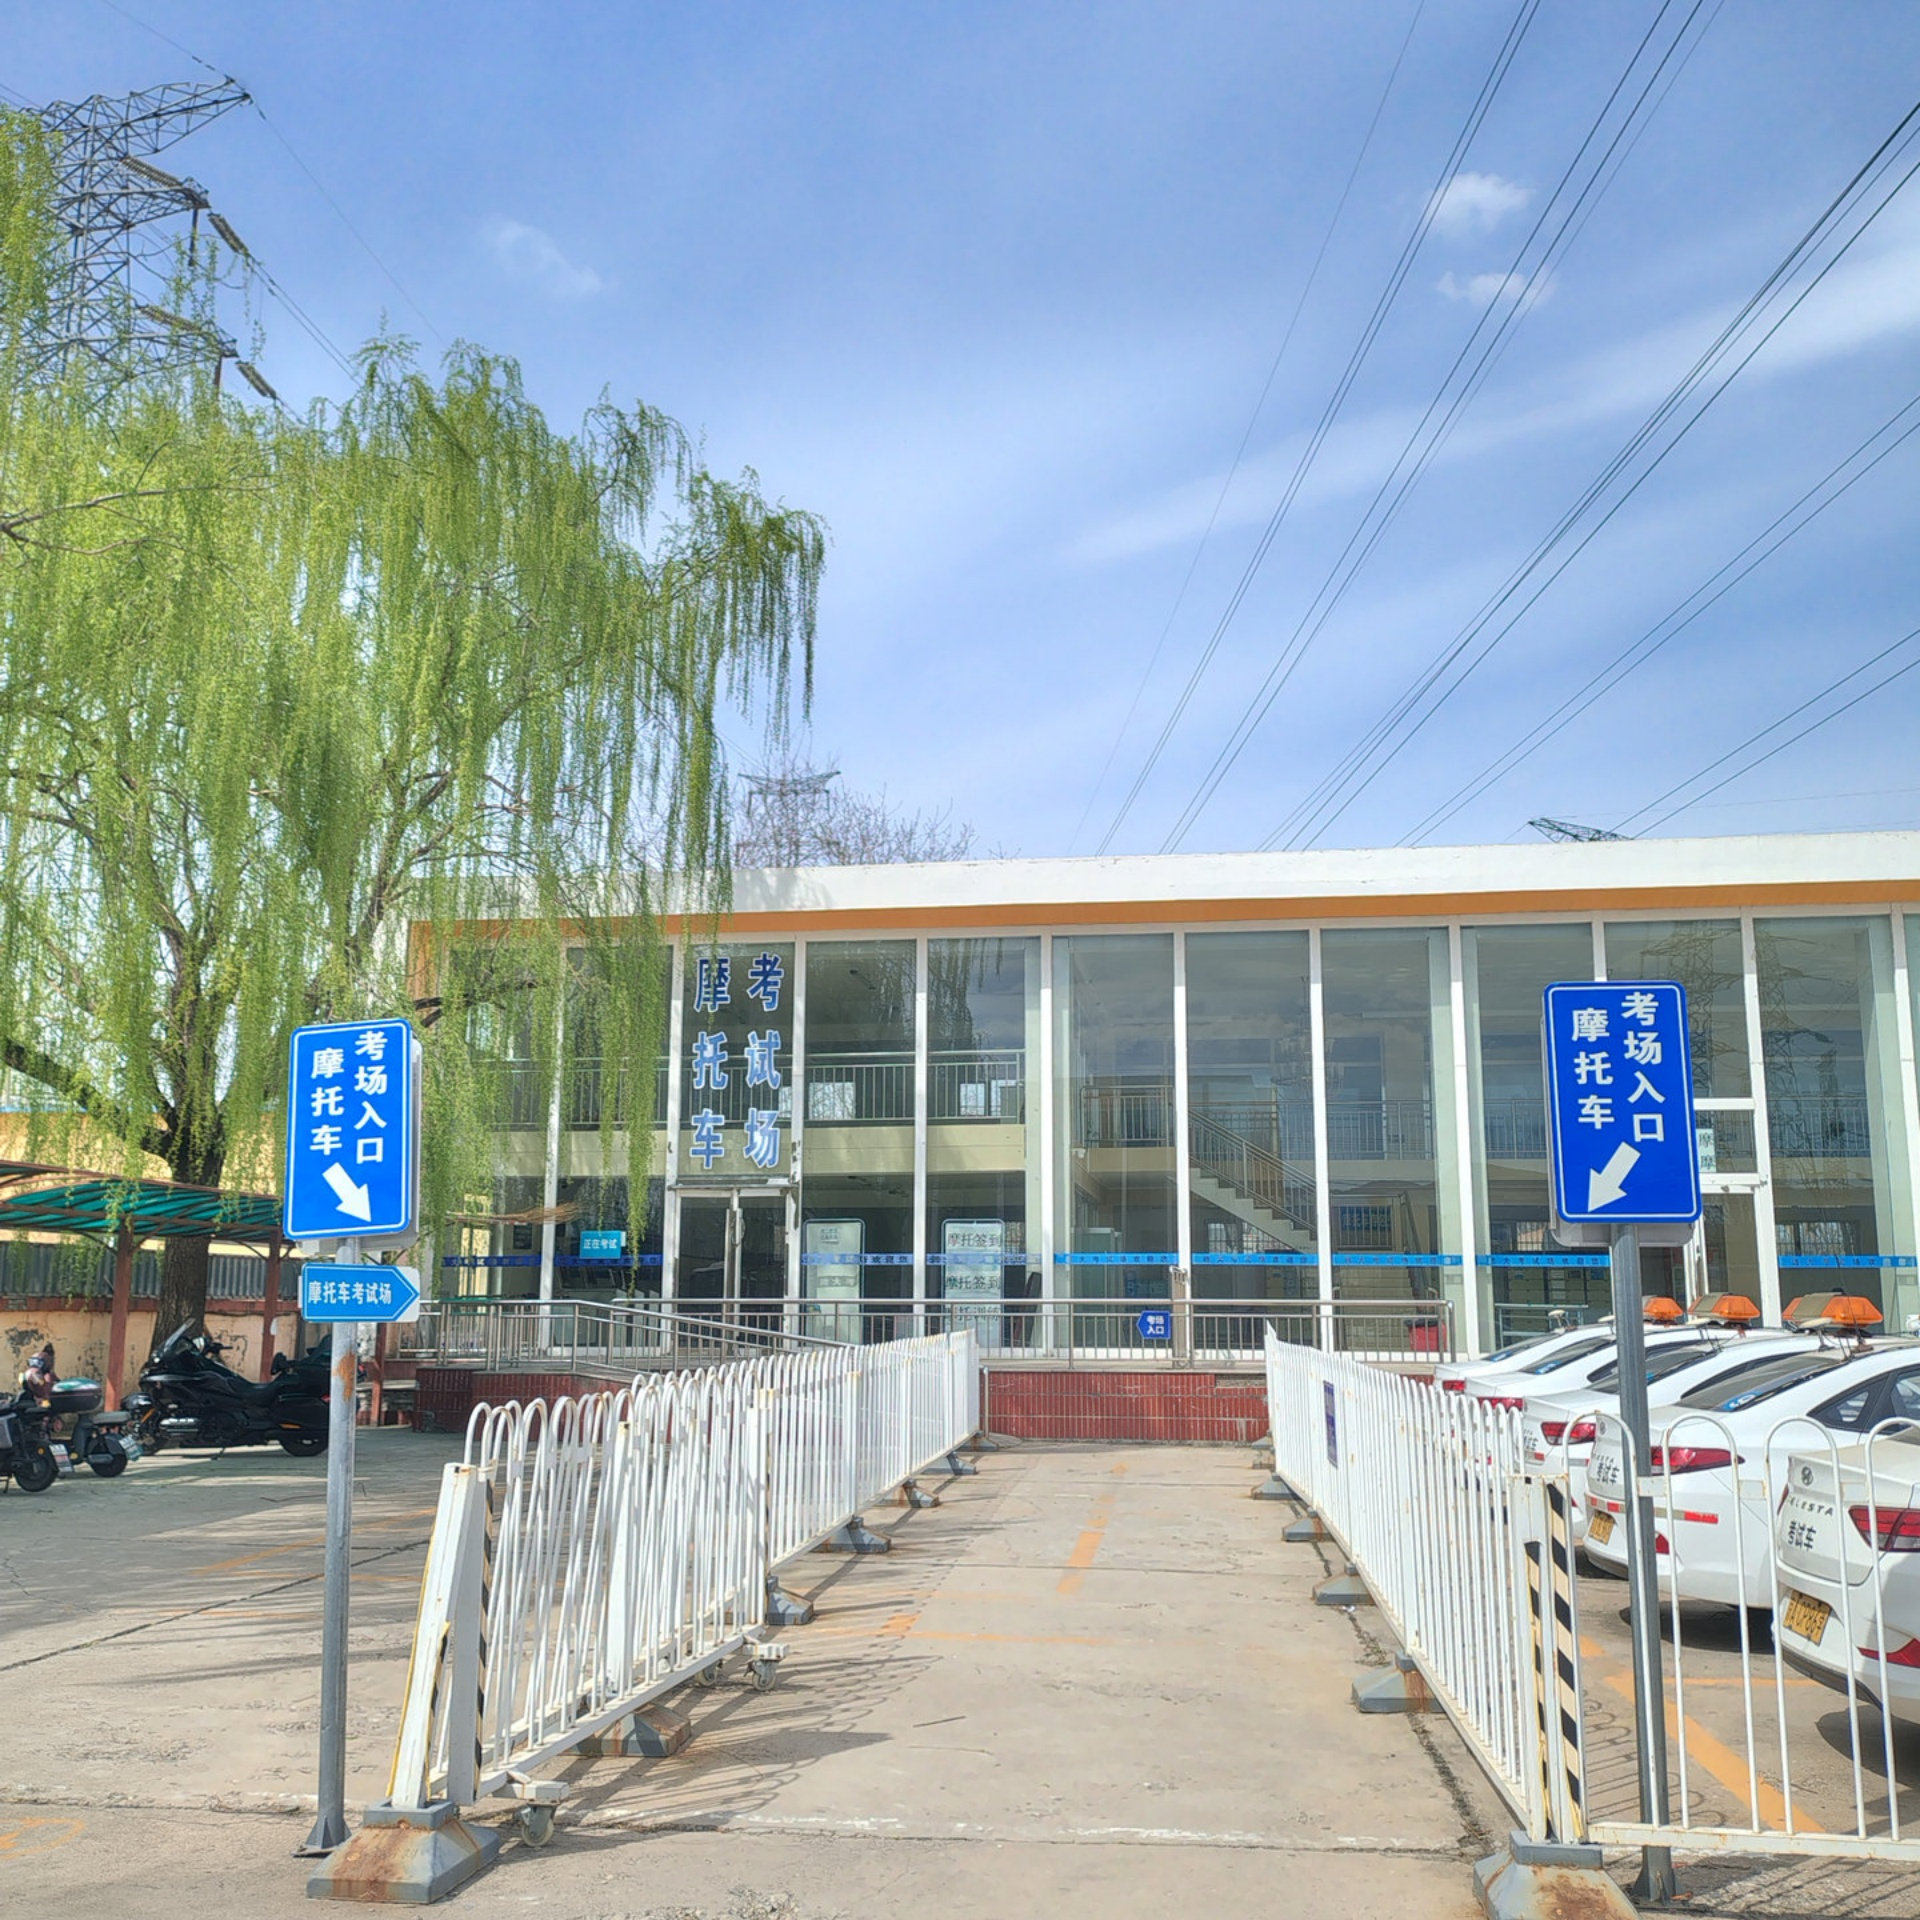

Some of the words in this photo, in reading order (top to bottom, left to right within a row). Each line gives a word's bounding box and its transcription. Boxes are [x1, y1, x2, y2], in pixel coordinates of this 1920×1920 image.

[309, 1047, 345, 1156] 摩托车
[354, 1030, 388, 1164] 考场入口
[690, 956, 731, 1170] 摩托车
[743, 952, 785, 1169] 考试场
[1571, 1007, 1616, 1130] 摩托车
[1621, 991, 1666, 1143] 考场入口
[308, 1281, 392, 1305] 摩托车考试场
[1146, 1325, 1165, 1335] 入口
